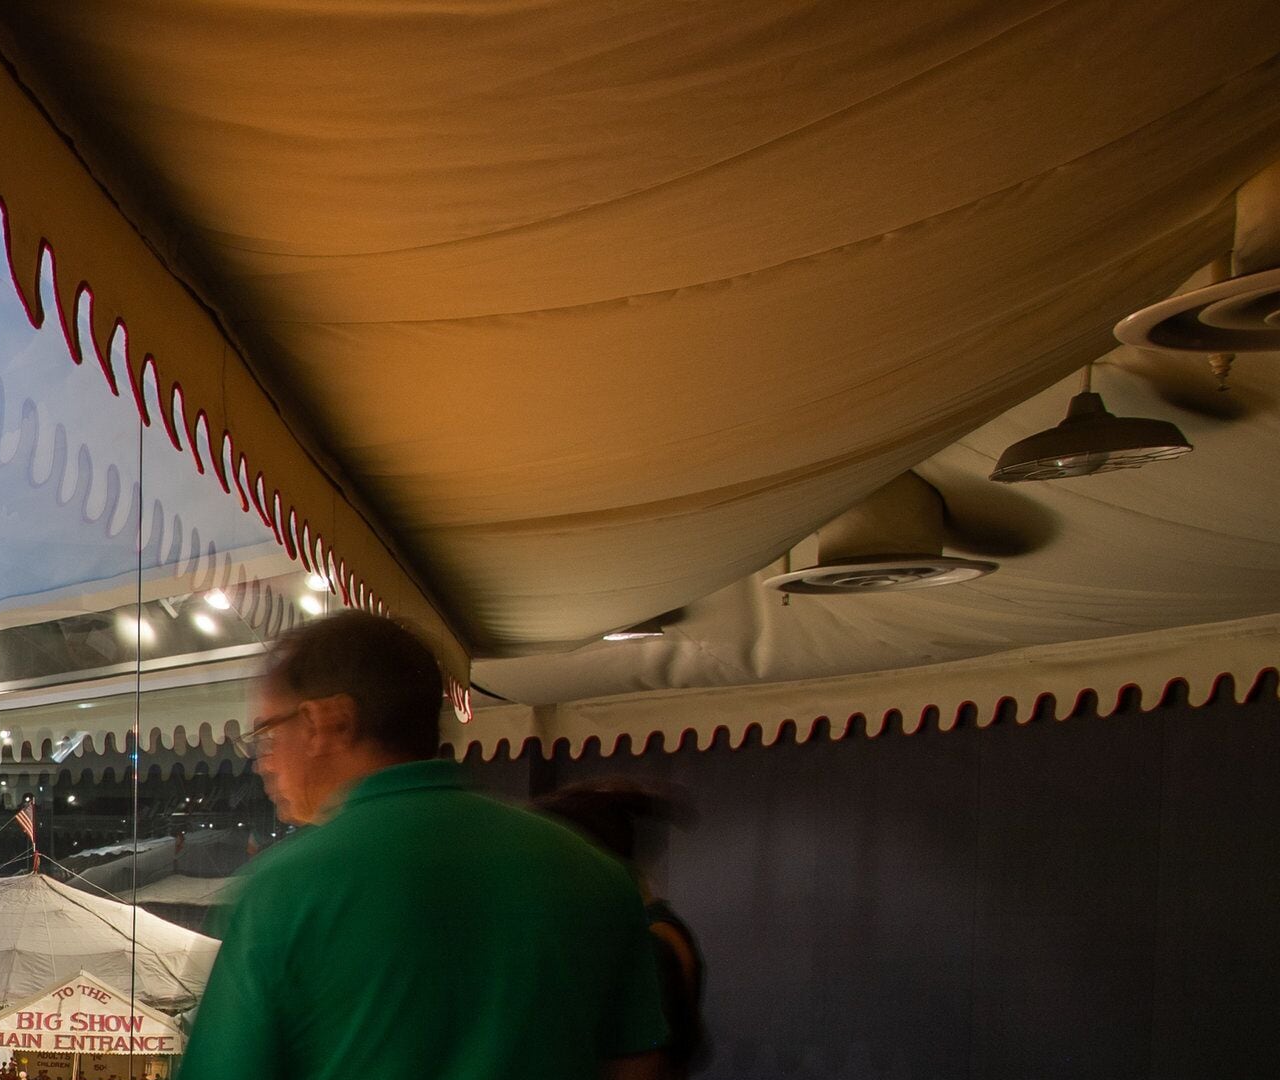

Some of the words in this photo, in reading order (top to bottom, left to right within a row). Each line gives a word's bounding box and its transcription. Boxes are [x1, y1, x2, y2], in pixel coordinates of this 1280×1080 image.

[52, 986, 74, 1001] TO
[77, 984, 111, 1004] THE
[16, 1011, 62, 1031] BIG
[70, 1011, 144, 1033] SHOW
[54, 1034, 174, 1051] ENTRANCE
[37, 1061, 70, 1069] CHILDREN
